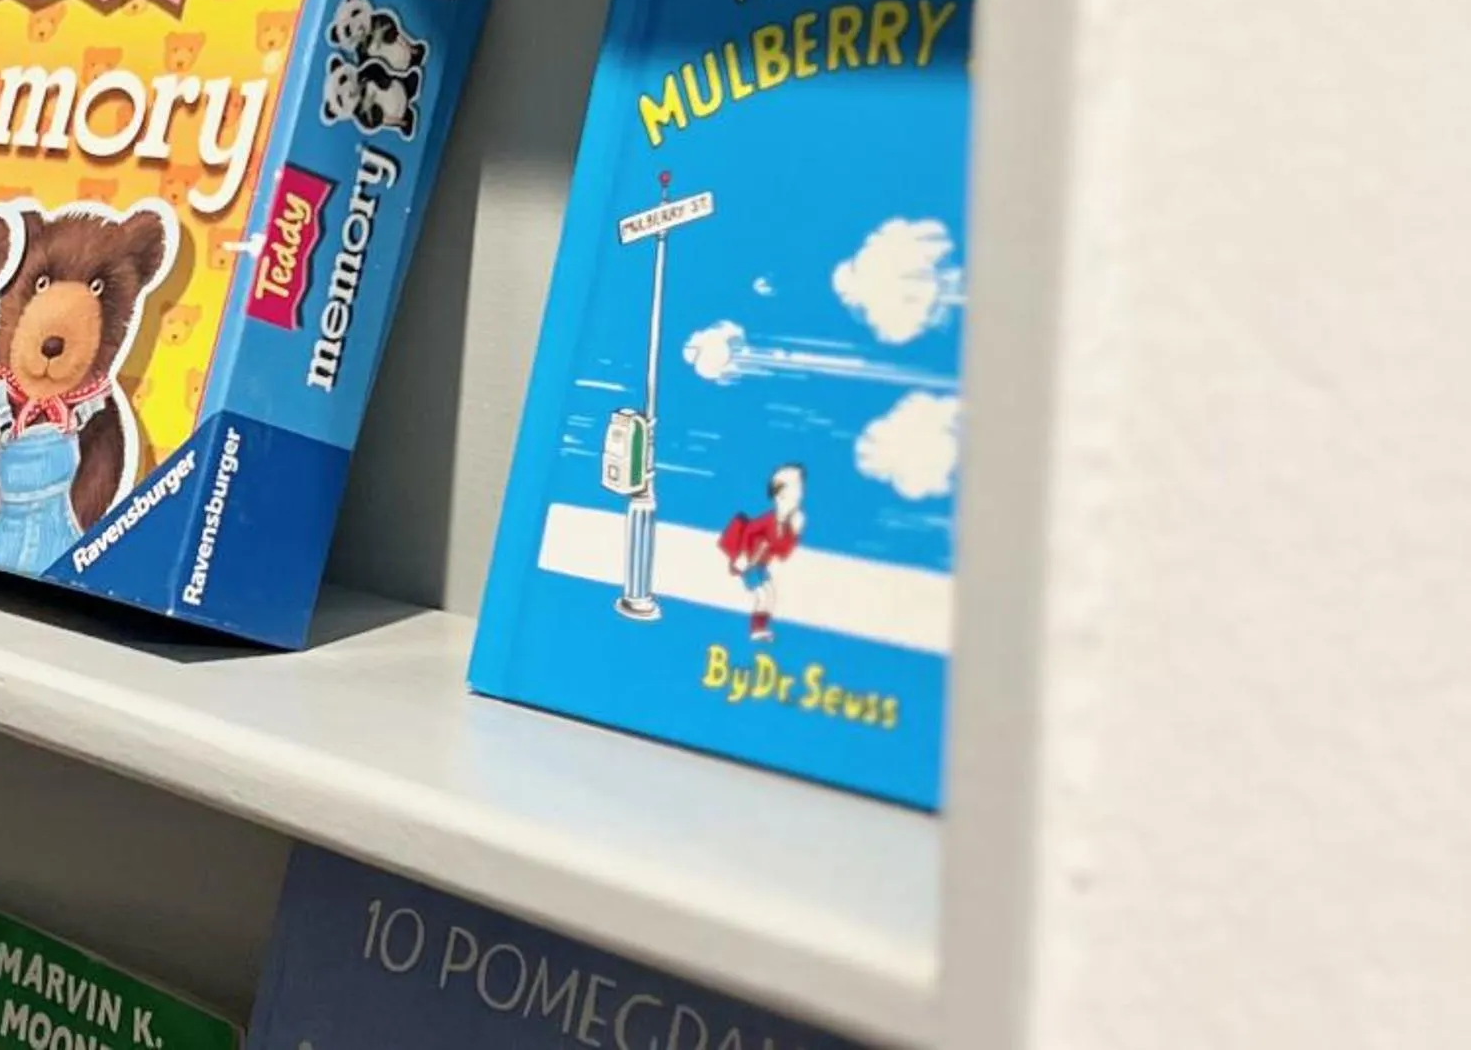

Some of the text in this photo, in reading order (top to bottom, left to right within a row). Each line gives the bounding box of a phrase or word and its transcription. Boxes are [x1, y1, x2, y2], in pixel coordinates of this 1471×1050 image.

[256, 196, 313, 300] Teddy
[305, 147, 399, 393] memory
[73, 450, 196, 572] Ravensburger
[183, 426, 241, 605] Ravensburger
[703, 644, 751, 703] By
[801, 664, 899, 729] Seuss
[363, 900, 426, 973] 10
[0, 999, 112, 1050] MOON
[132, 1006, 164, 1049] K.
